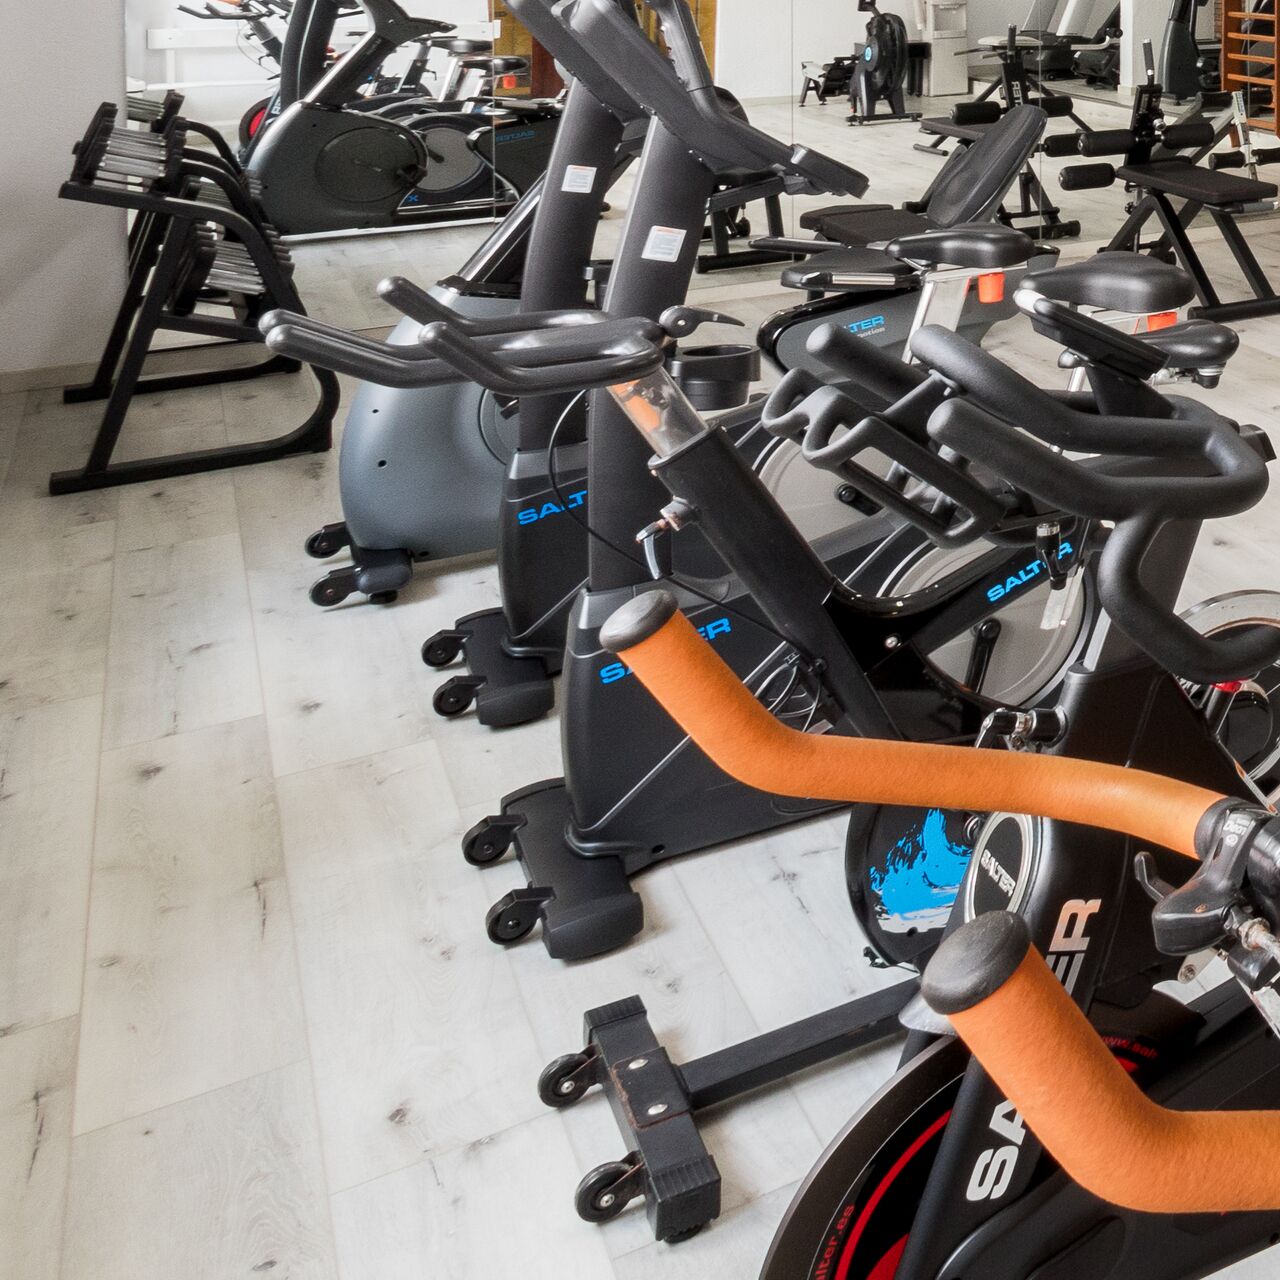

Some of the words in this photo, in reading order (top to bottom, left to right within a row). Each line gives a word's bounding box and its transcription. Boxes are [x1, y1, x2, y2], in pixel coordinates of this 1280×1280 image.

[848, 315, 885, 334] TER
[517, 489, 588, 526] SALT
[986, 542, 1073, 603] SALTR
[600, 617, 732, 685] SER
[980, 848, 1017, 898] SALTER
